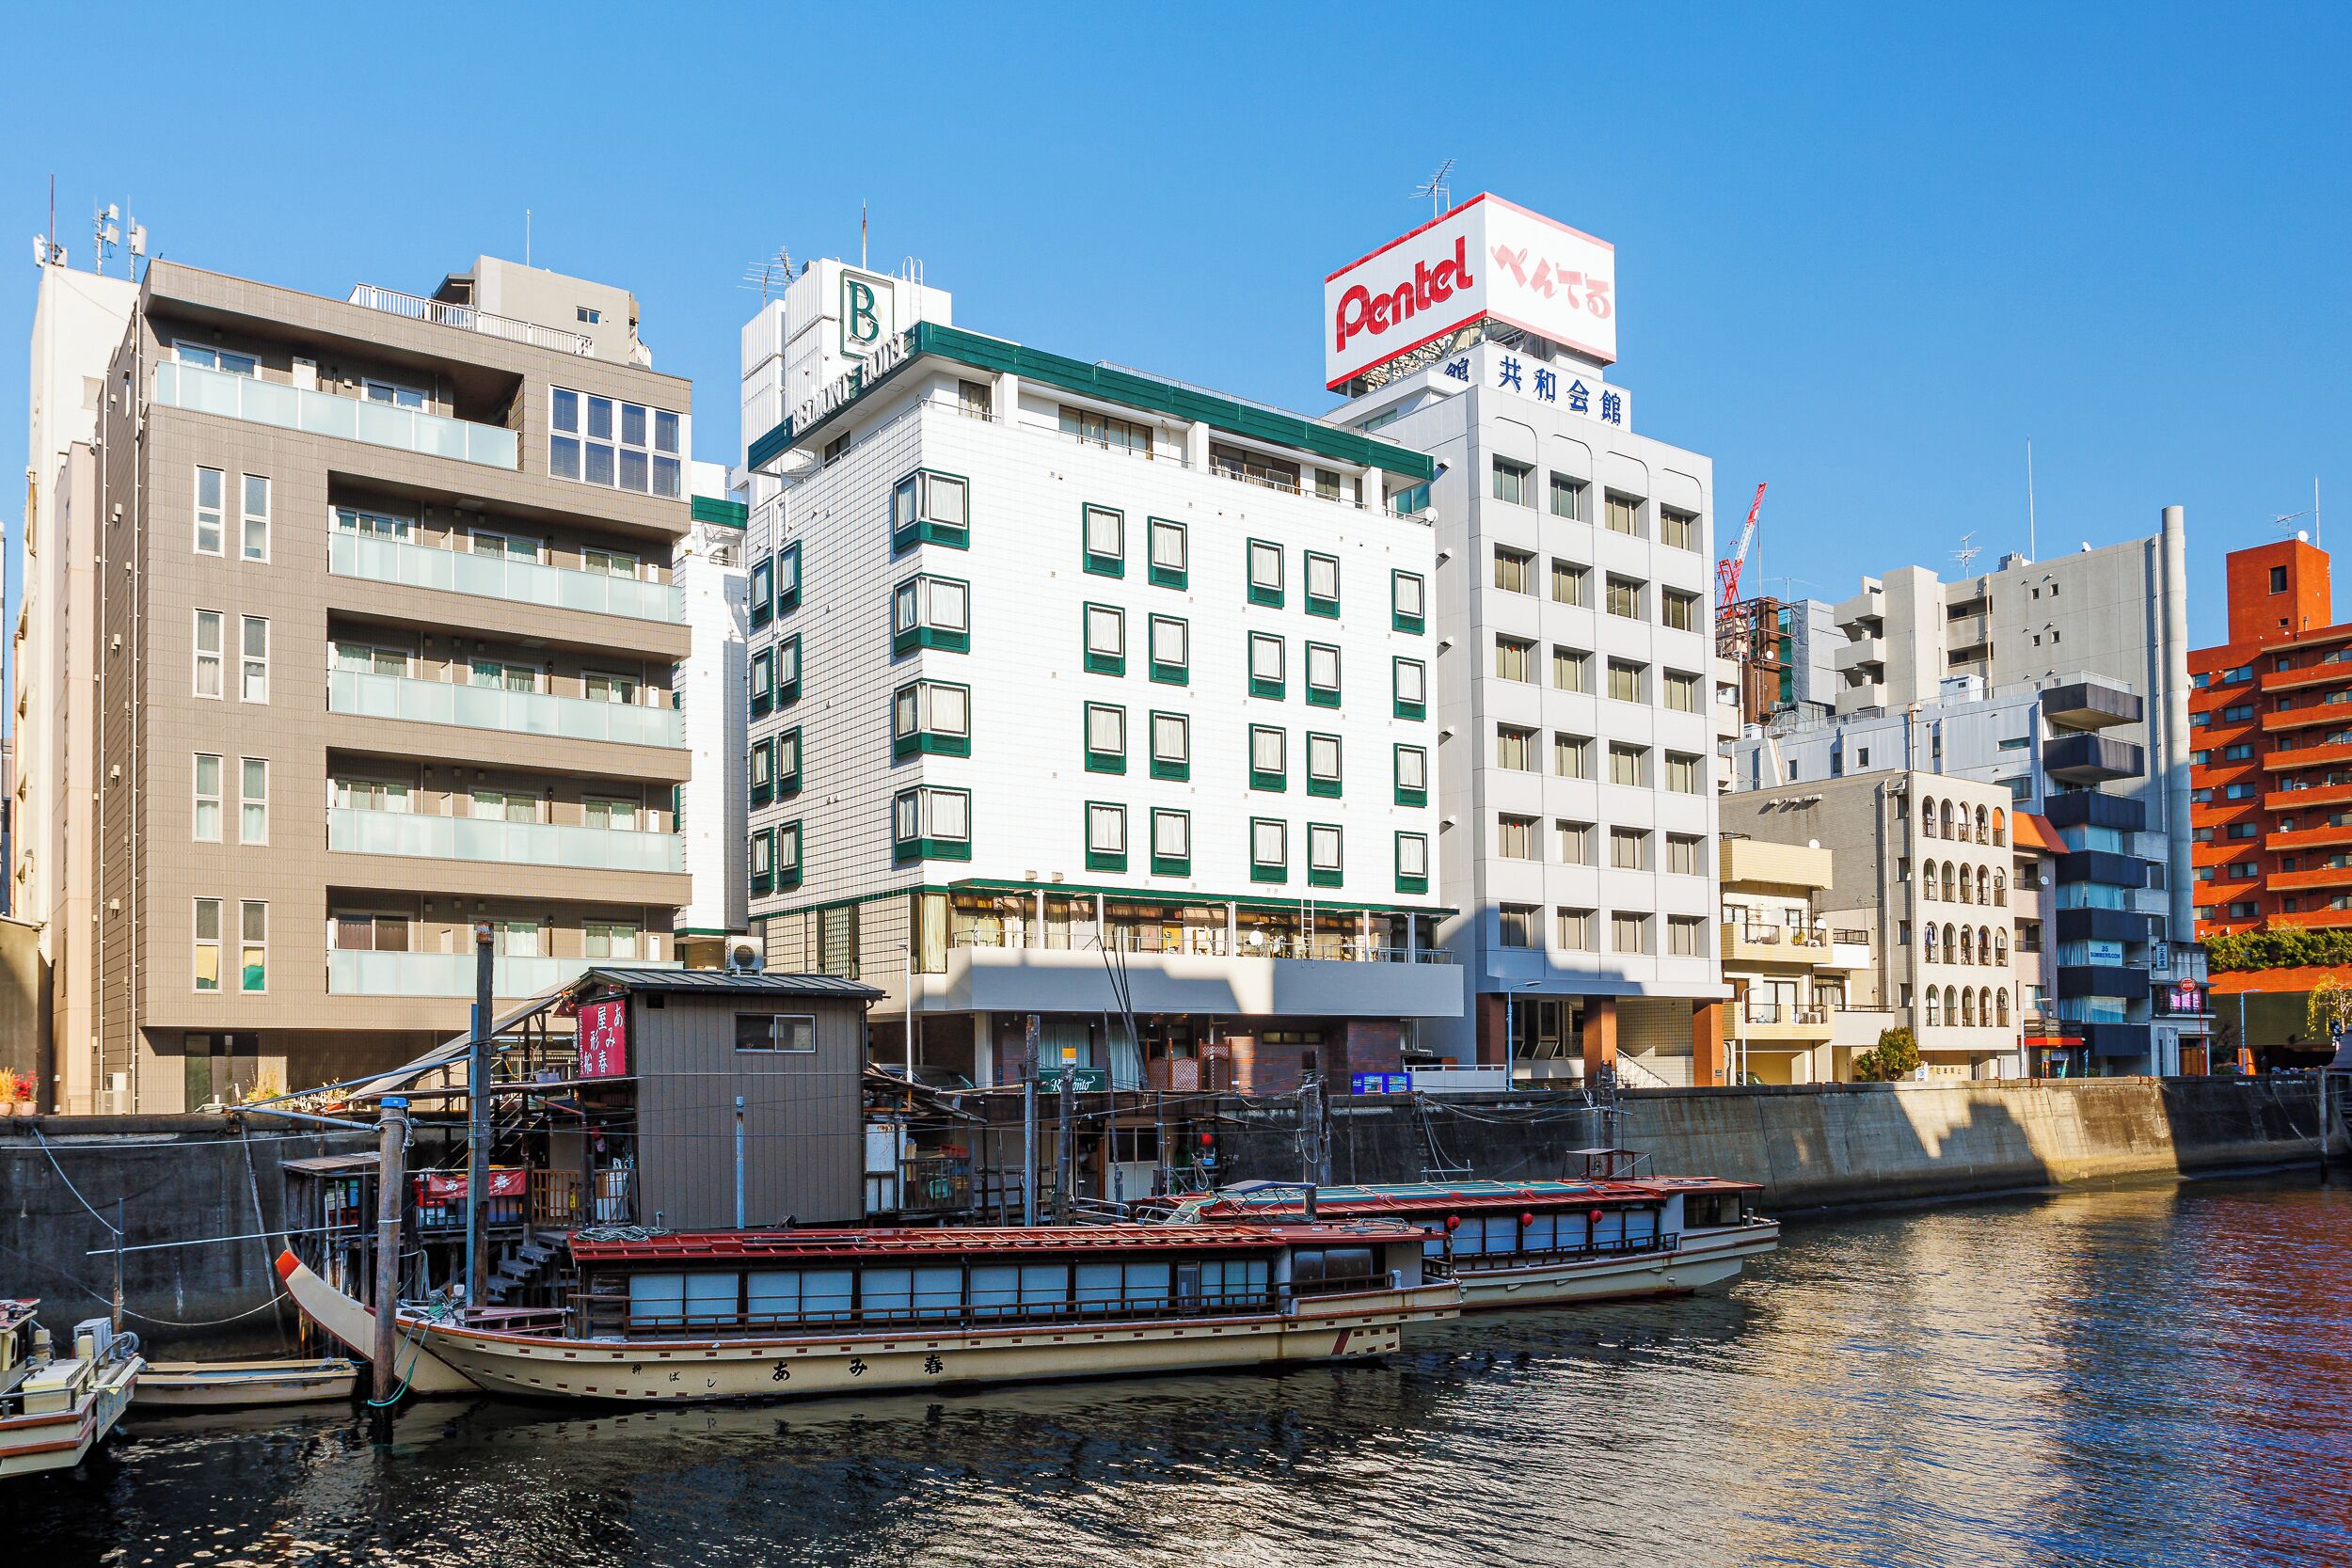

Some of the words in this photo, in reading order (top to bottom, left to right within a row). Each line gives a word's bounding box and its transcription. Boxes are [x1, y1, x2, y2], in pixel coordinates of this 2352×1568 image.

[847, 280, 880, 341] B
[1336, 235, 1473, 353] Pentel
[1490, 244, 1611, 319] ぺんてる
[792, 368, 853, 436] BELMONT
[861, 332, 908, 388] HOTEL
[1498, 355, 1621, 426] 共和会館
[772, 1354, 944, 1383] あみ春
